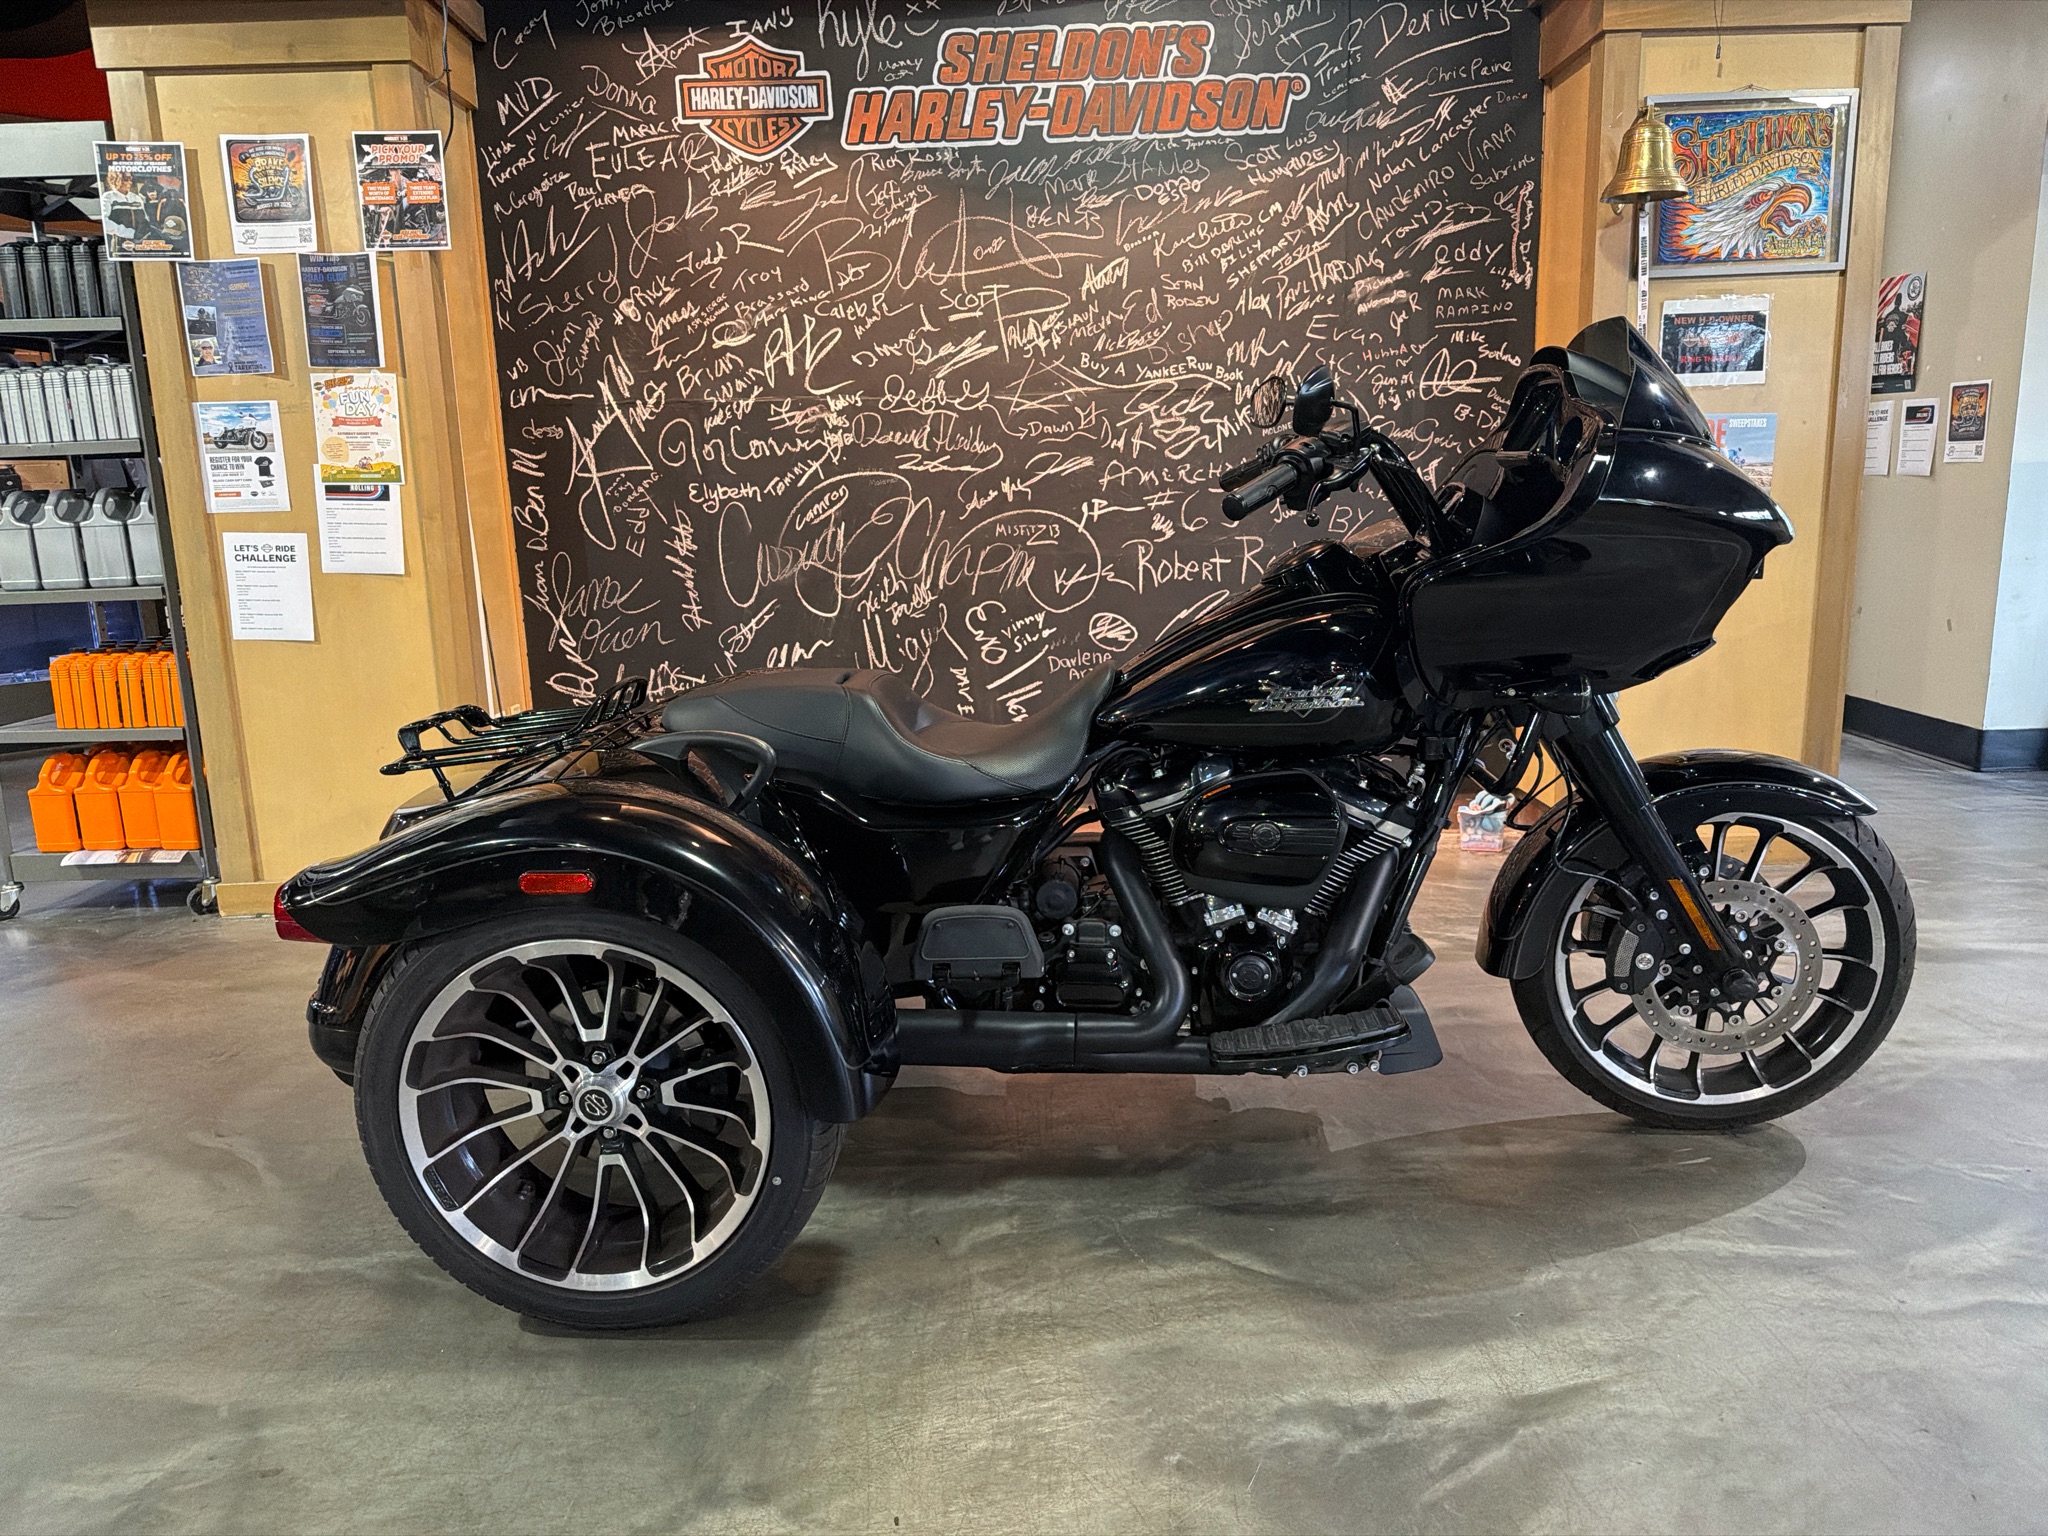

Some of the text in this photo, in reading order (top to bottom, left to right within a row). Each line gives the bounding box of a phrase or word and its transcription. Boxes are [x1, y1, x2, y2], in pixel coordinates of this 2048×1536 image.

[938, 25, 1211, 84] SHELDON'S
[718, 60, 786, 79] MOTOR
[580, 65, 658, 116] Donna
[690, 84, 819, 110] HARLEY-DAVIDSON
[720, 117, 792, 147] CYCLES
[371, 144, 425, 153] PICK YOUR
[1368, 95, 1492, 195] Nolan Lancaster
[106, 153, 119, 161] UP
[120, 153, 133, 161] TO
[254, 157, 285, 171] BRAKE
[378, 154, 419, 163] PROMO!
[257, 176, 285, 187] SILENCE
[1697, 150, 1820, 203] HARLEY-DAVIDSON
[564, 178, 602, 203] Paul
[671, 241, 728, 282] Todd
[1181, 252, 1211, 274] Bill
[517, 222, 622, 325] Sherry
[732, 266, 783, 293] Troy
[1160, 272, 1205, 293] SEAN
[1235, 286, 1273, 320] Alex
[1437, 286, 1490, 302] MARK
[815, 300, 867, 321] Caleb
[1435, 301, 1514, 320] RAMPINO
[1674, 316, 1696, 325] NEW
[1719, 314, 1754, 322] OWNER
[1114, 361, 1127, 377] A
[1135, 361, 1188, 383] YANKEE
[1186, 355, 1214, 371] RUN
[1681, 355, 1701, 363] RING
[676, 352, 745, 399] Brian
[340, 390, 370, 404] FUN
[345, 403, 376, 416] DAY
[1028, 420, 1075, 437] Dawn
[1729, 418, 1767, 427] SWEEPSTAKES
[688, 482, 763, 514] Elybeth
[234, 554, 297, 562] CHALLENGE
[1121, 538, 1231, 595] Robert
[1001, 611, 1046, 639] Vinny
